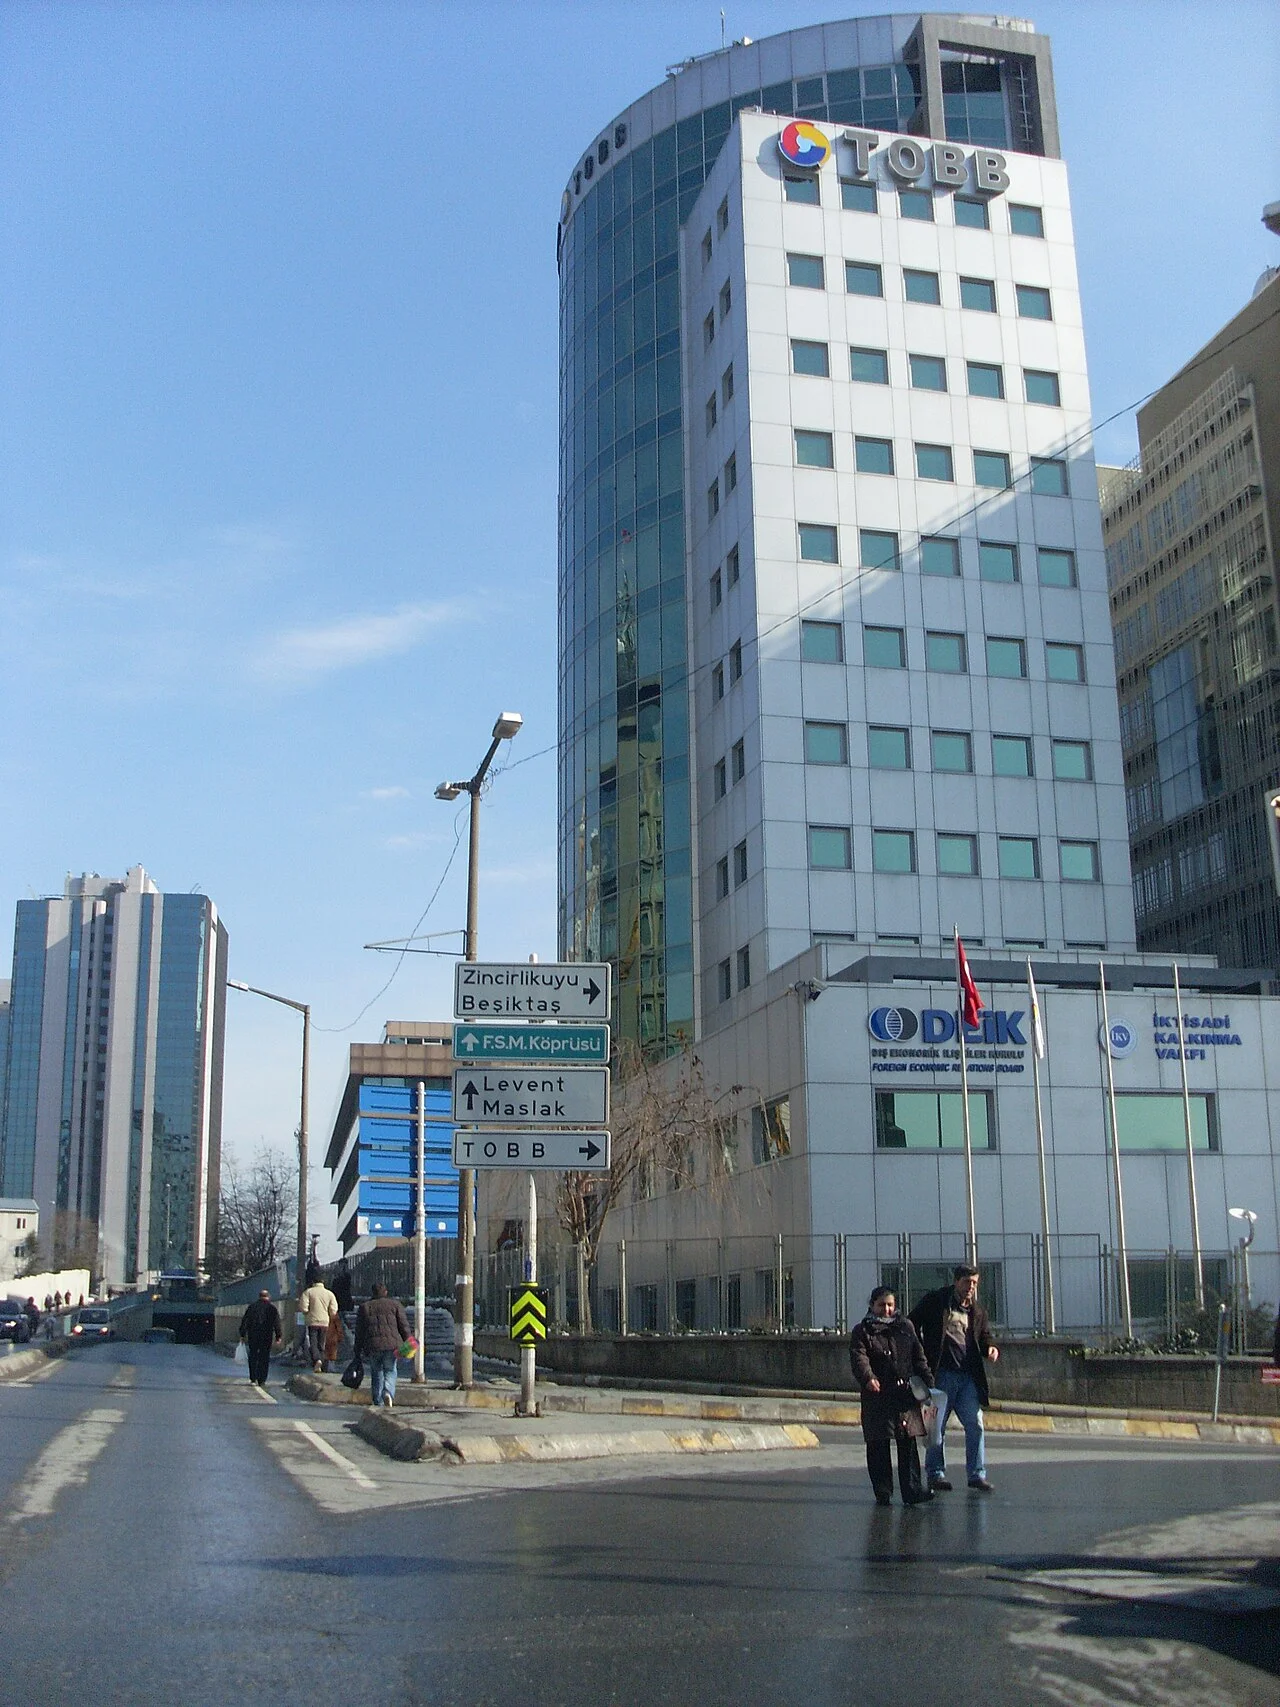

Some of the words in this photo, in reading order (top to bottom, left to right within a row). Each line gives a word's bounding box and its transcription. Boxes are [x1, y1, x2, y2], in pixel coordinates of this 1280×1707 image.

[843, 130, 1010, 197] TOBB
[463, 969, 579, 989] Zincirlikuyu
[462, 995, 561, 1014] Beşiktaş
[872, 1063, 907, 1072] FOREIGN
[951, 1063, 995, 1073] REATIONS
[483, 1076, 565, 1092] Levent
[483, 1100, 565, 1116] Maslak
